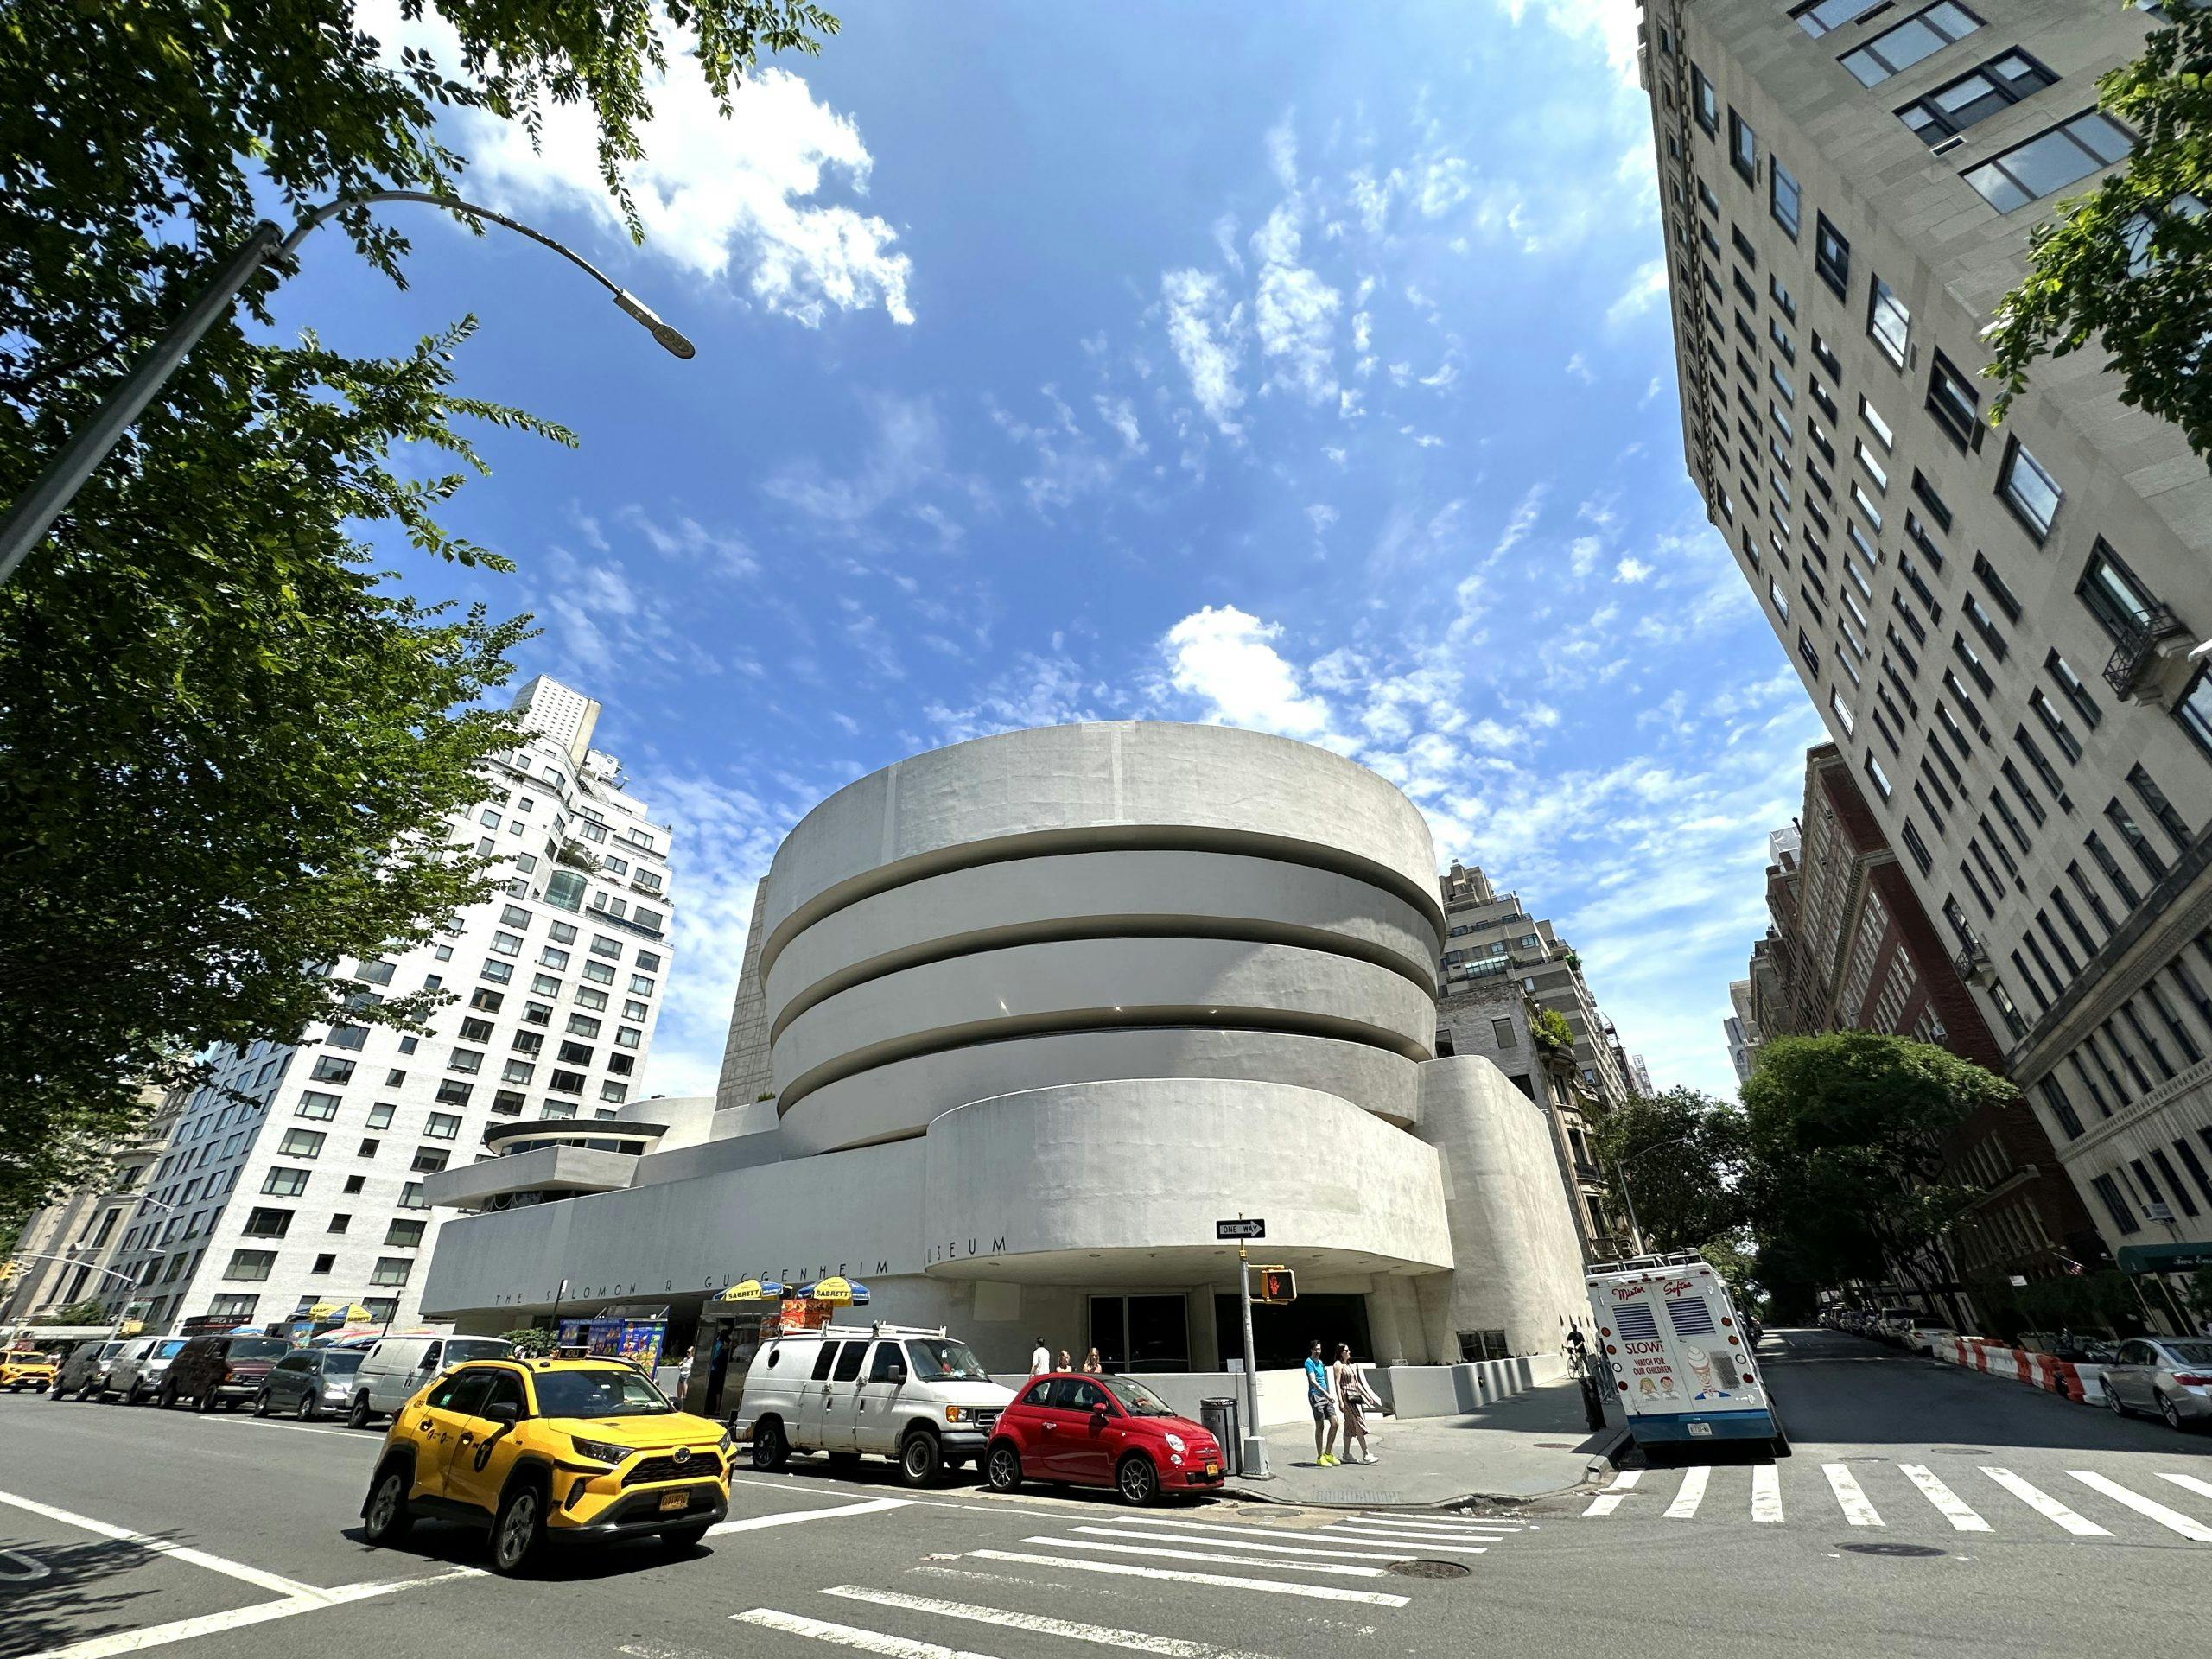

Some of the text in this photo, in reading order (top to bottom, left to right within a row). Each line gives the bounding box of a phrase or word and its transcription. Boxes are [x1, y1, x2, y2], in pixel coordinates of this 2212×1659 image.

[1243, 1224, 1257, 1233] WAY
[495, 1293, 523, 1306] THE
[665, 1280, 672, 1291] R
[704, 1261, 888, 1287] GUGGENHEIM
[923, 1236, 1007, 1266] USEUM
[728, 1289, 760, 1300] SABRETT
[1611, 1281, 1694, 1300] Mister Softee
[1625, 1341, 1664, 1355] SLOW!
[1633, 1367, 1645, 1376] OUR
